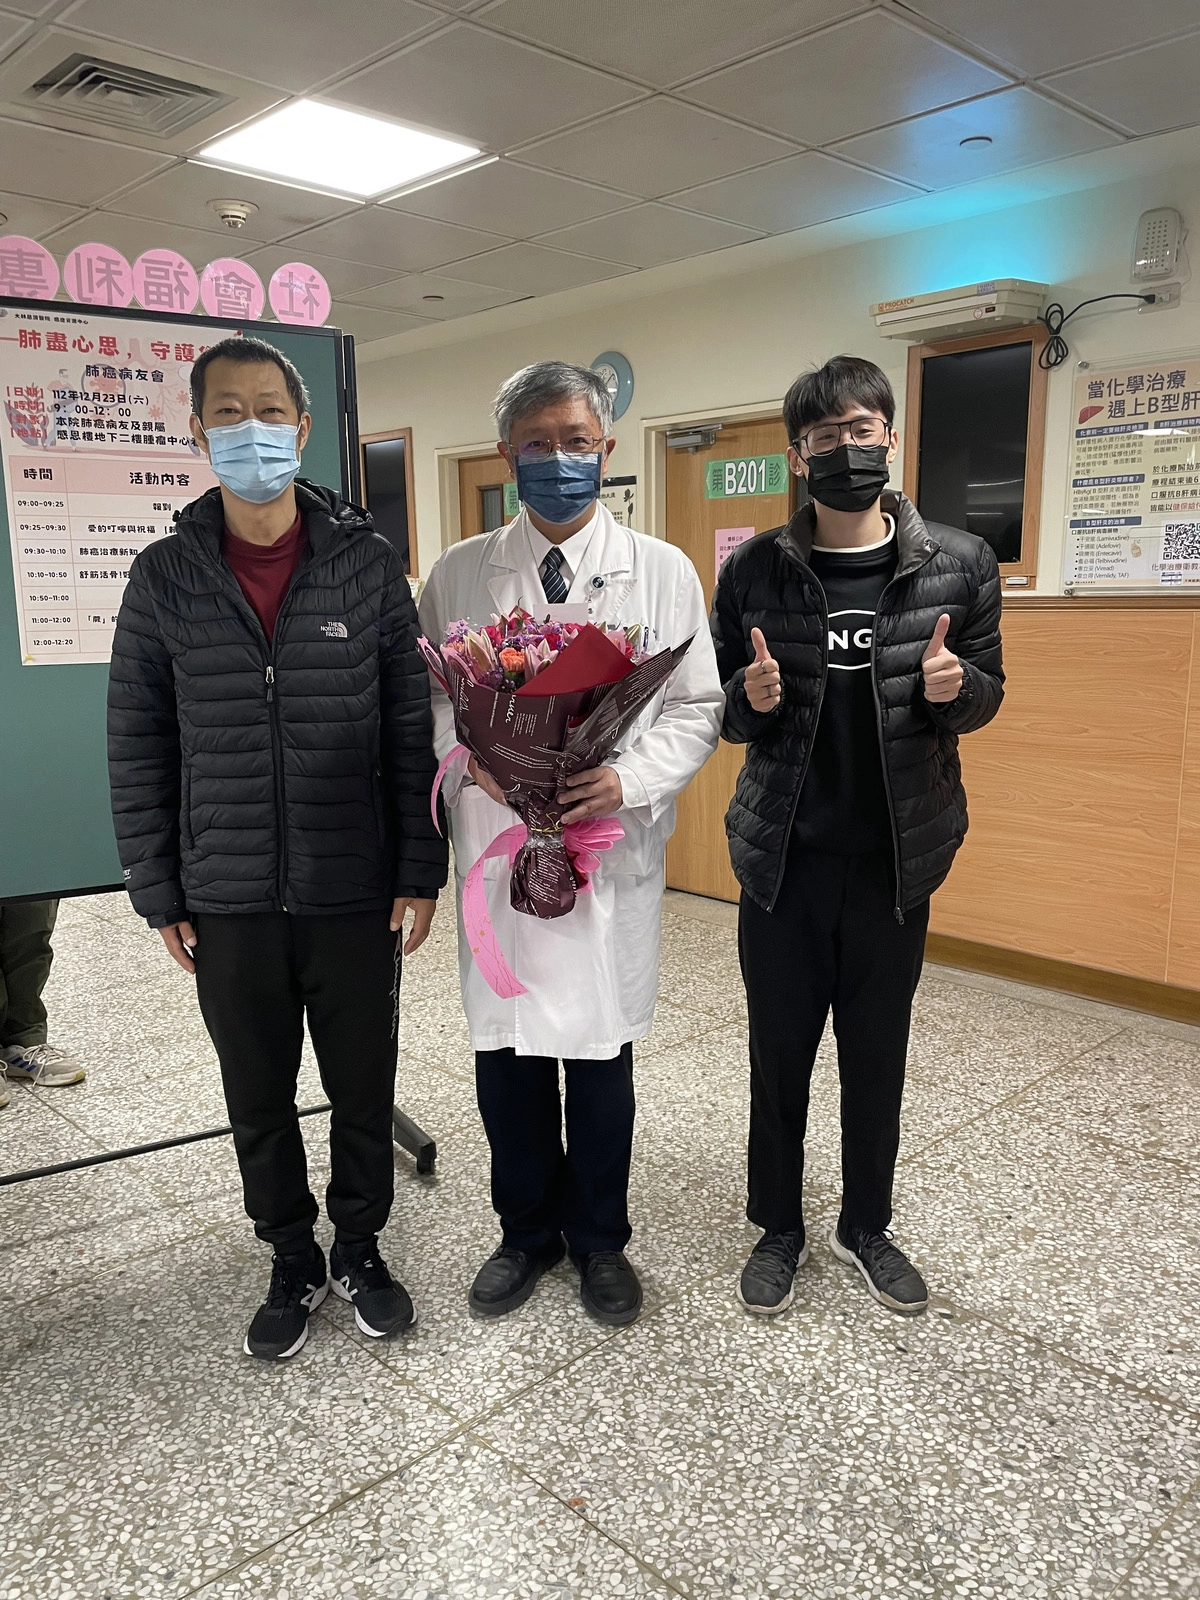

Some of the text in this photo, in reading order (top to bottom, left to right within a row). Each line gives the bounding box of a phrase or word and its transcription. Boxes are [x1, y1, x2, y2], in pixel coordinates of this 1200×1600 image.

[884, 298, 915, 309] PROCATCH
[19, 329, 211, 362] 肺盡心思，守護
[86, 365, 164, 383] 肺癌病友會
[1088, 370, 1186, 400] 當化學治療
[1107, 391, 1200, 419] 遇上B型肝
[56, 416, 166, 432] 本院肺癌病友及親屬
[23, 468, 53, 480] 時間
[129, 471, 190, 486] 活動內容
[1151, 563, 1200, 571] 化學治療衛教
